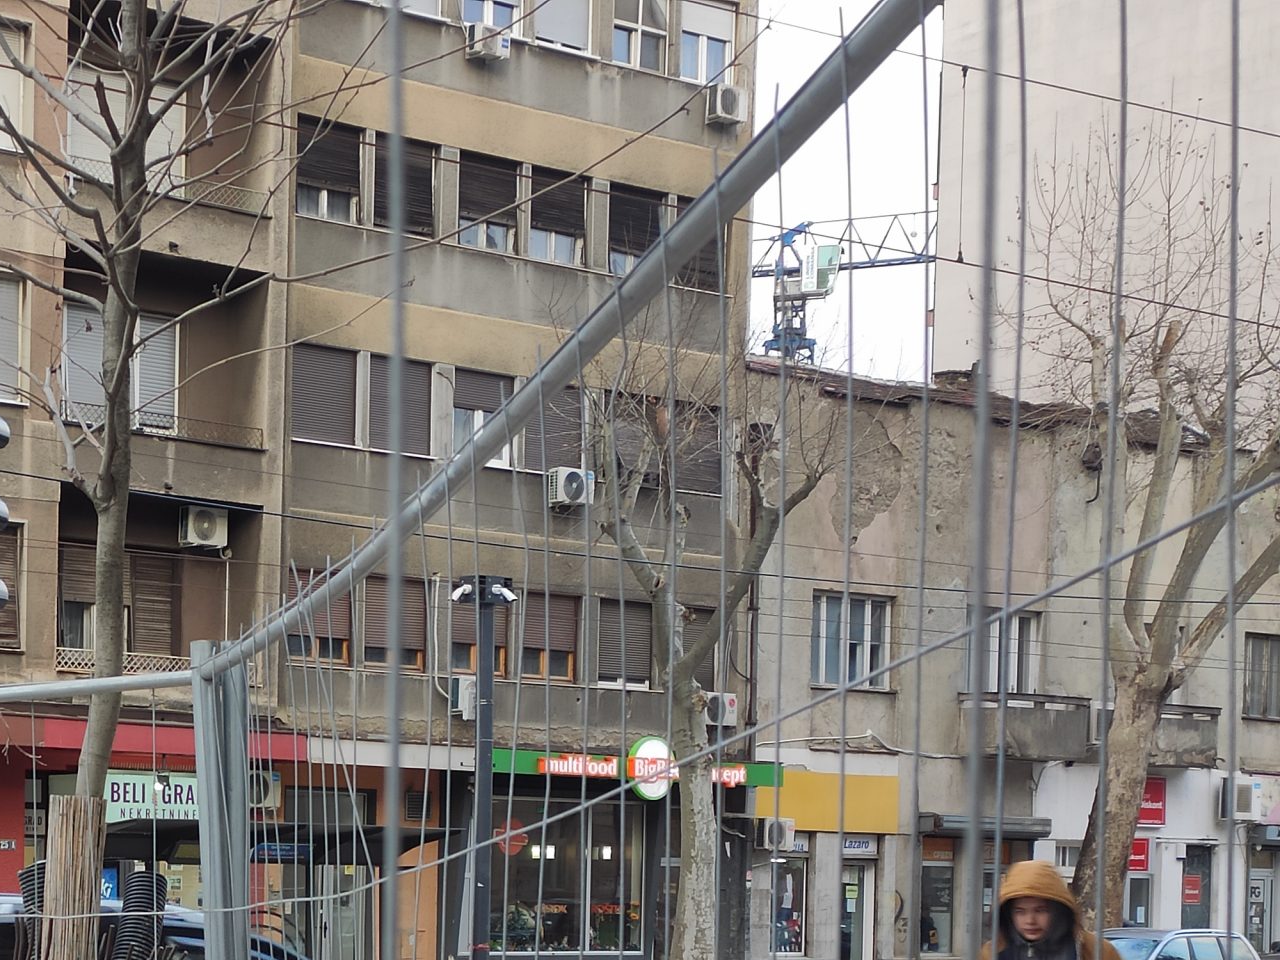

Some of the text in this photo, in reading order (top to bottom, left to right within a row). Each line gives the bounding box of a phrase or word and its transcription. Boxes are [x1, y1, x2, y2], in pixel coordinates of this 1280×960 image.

[545, 758, 618, 777] multifood
[111, 782, 196, 805] BELI GRA
